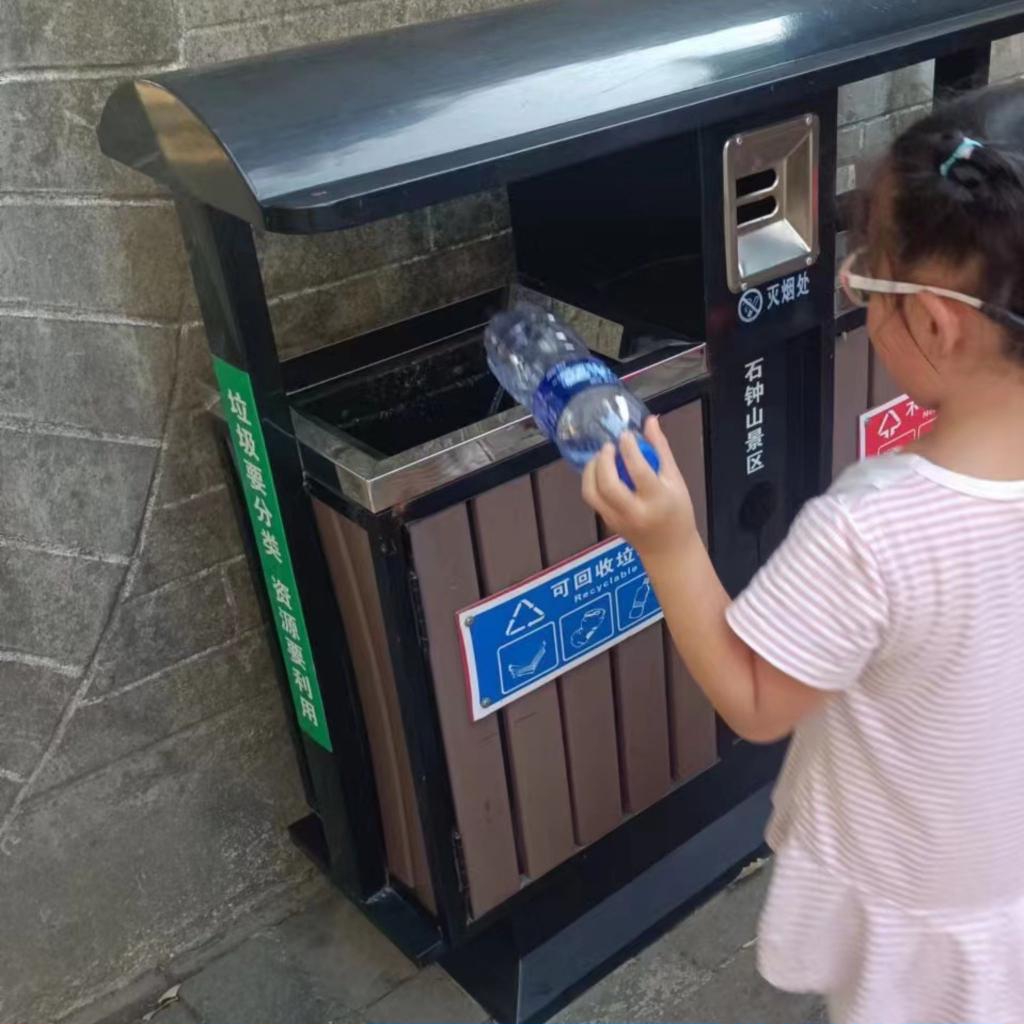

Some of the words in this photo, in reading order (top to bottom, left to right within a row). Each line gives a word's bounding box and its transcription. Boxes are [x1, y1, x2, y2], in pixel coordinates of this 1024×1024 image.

[766, 271, 809, 310] 灭烟处
[744, 357, 764, 475] 石钟山景区
[228, 388, 281, 564] 垃圾要分类
[271, 575, 318, 727] 资源要利用
[574, 565, 638, 603] Recyclable
